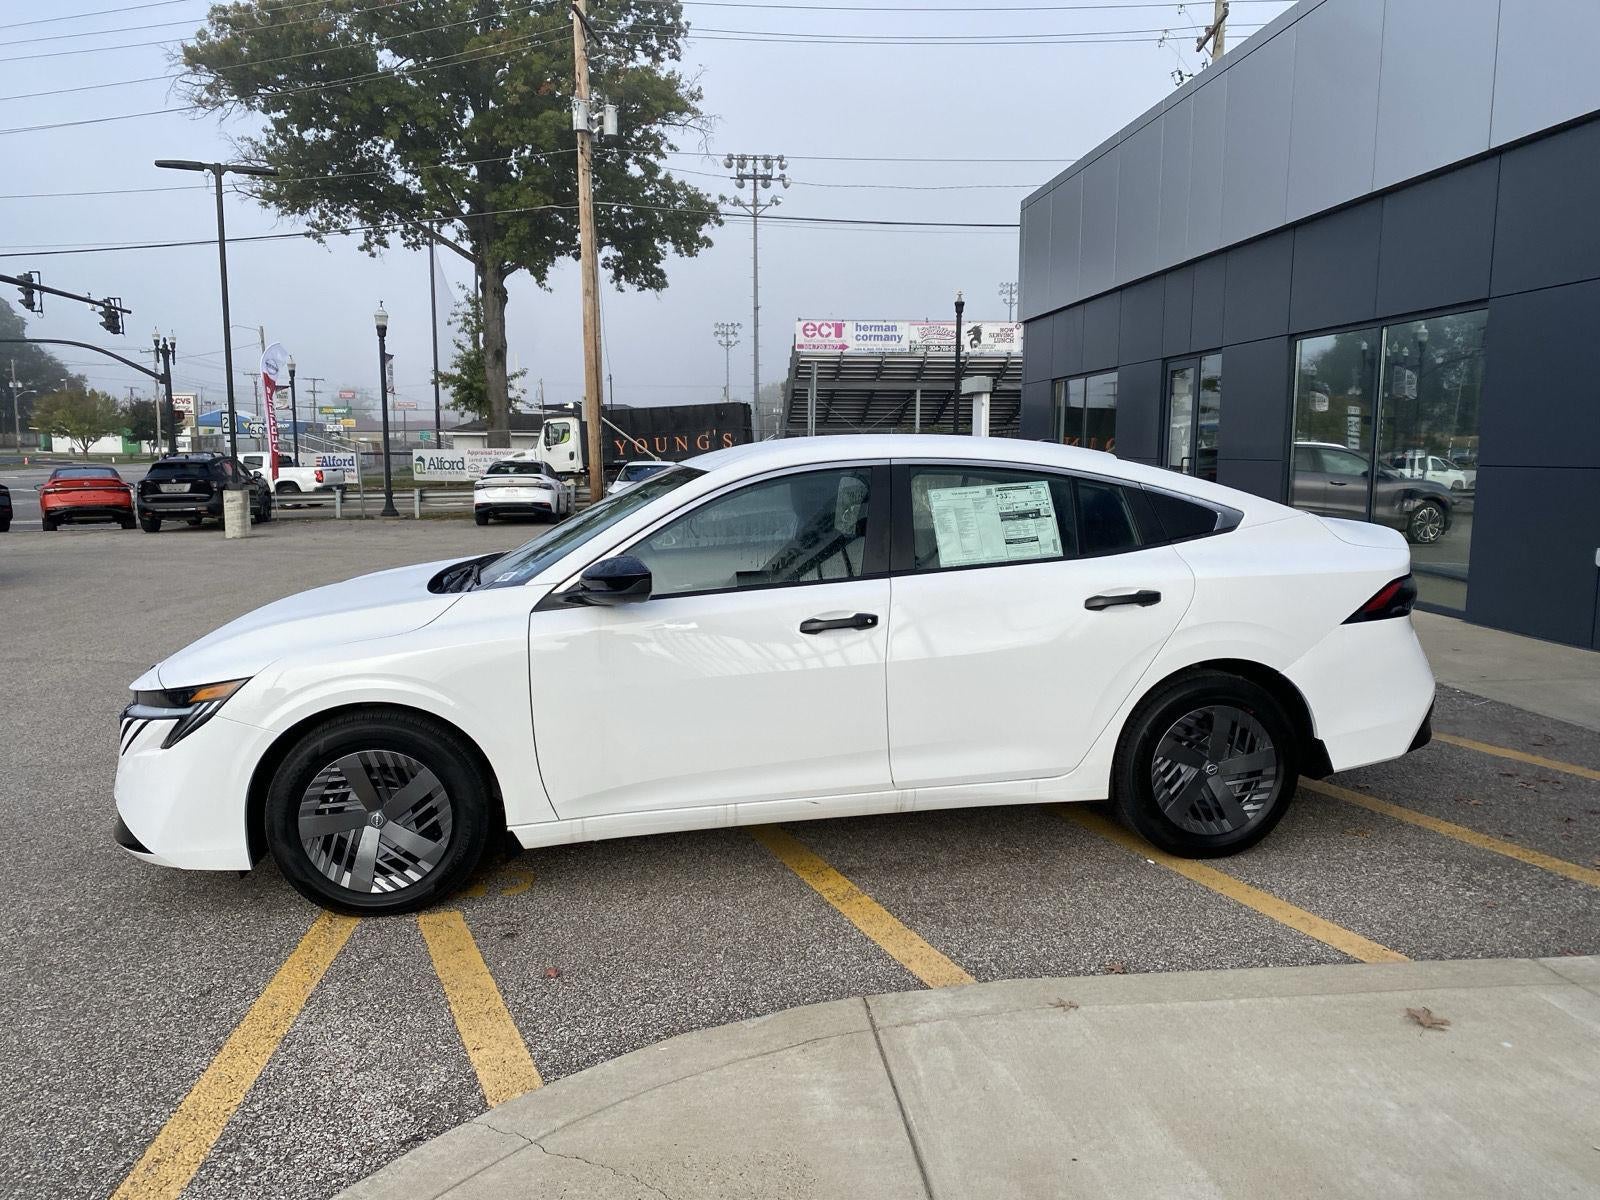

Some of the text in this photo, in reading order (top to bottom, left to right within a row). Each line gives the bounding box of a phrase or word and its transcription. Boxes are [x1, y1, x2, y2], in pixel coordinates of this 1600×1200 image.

[855, 322, 897, 332] herman
[854, 333, 903, 344] cormany
[266, 386, 279, 453] CERTIFIED
[251, 426, 264, 435] 60
[614, 429, 733, 456] YOUNG'S
[321, 455, 355, 467] Alford
[427, 457, 466, 471] Alford
